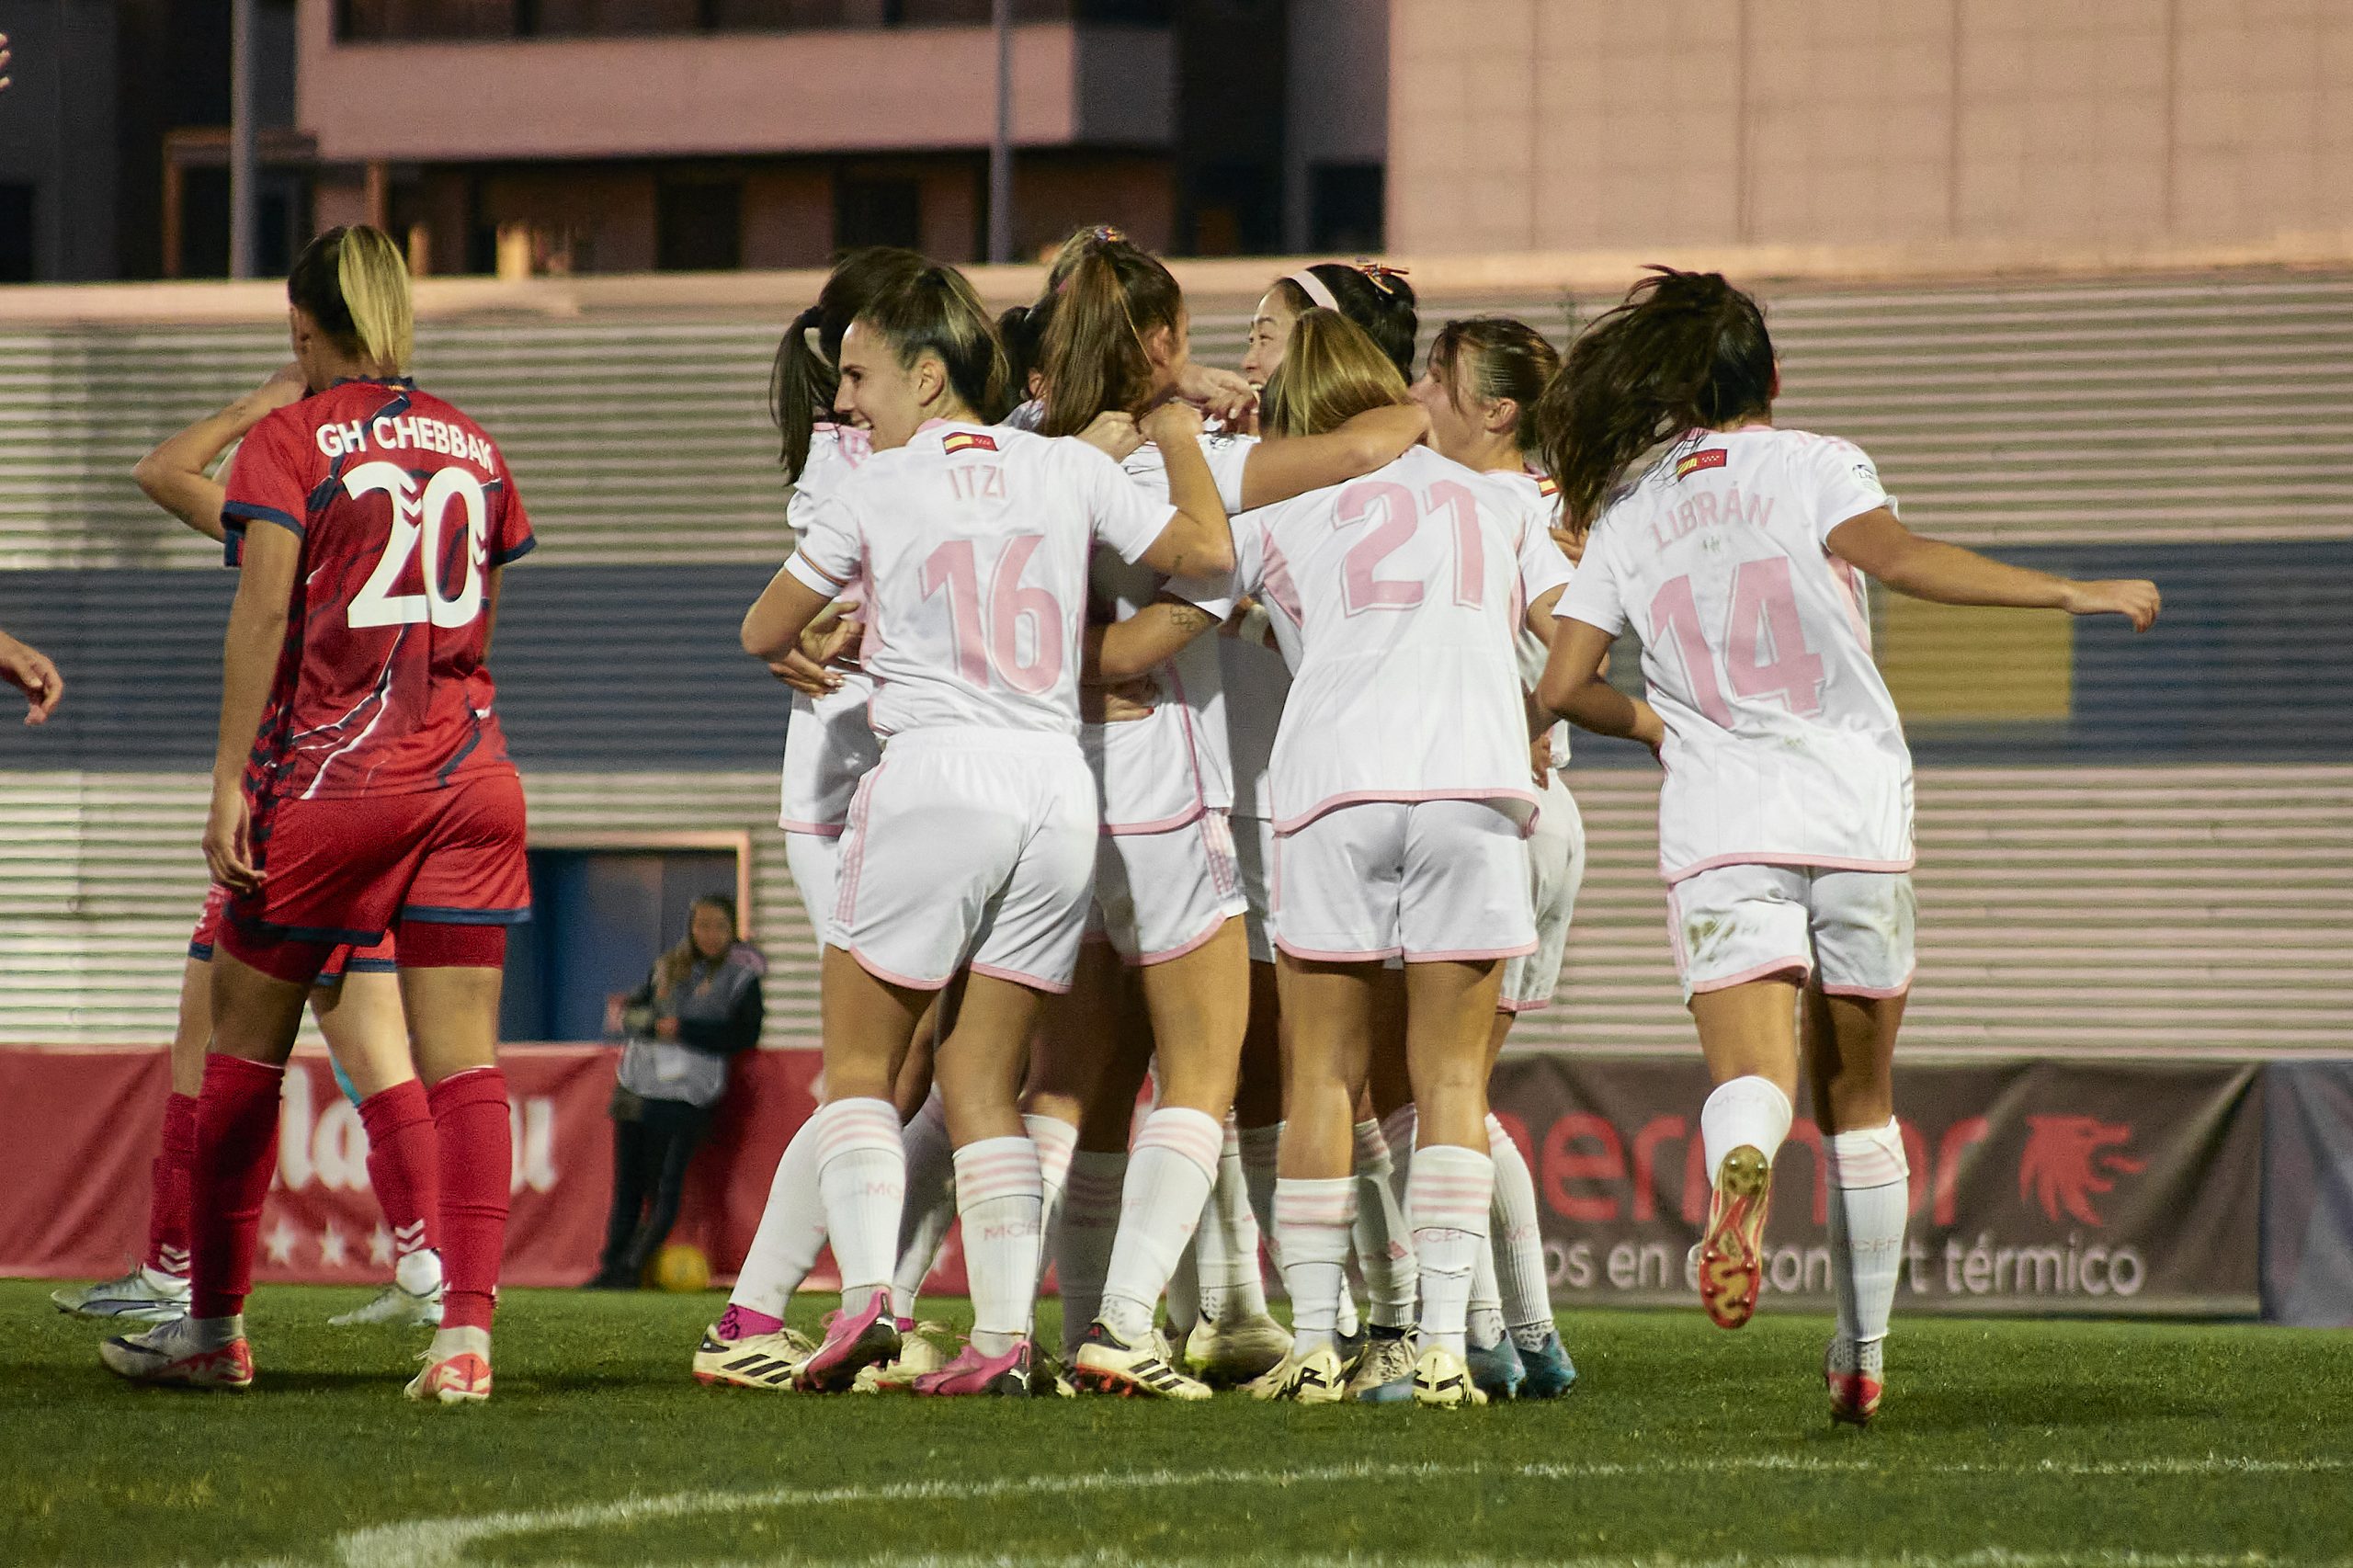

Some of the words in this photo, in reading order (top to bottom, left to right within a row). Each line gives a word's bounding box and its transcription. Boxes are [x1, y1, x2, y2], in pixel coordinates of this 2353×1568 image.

[315, 420, 367, 458] GH
[372, 416, 494, 475] CHEBBAK
[946, 464, 1006, 501] ITZI
[342, 461, 487, 629] 20
[920, 534, 1063, 695] 16
[1332, 480, 1484, 619] 21
[1649, 555, 1824, 729] 14
[1608, 1244, 1666, 1289] en
[1946, 1232, 2146, 1295] térmico
